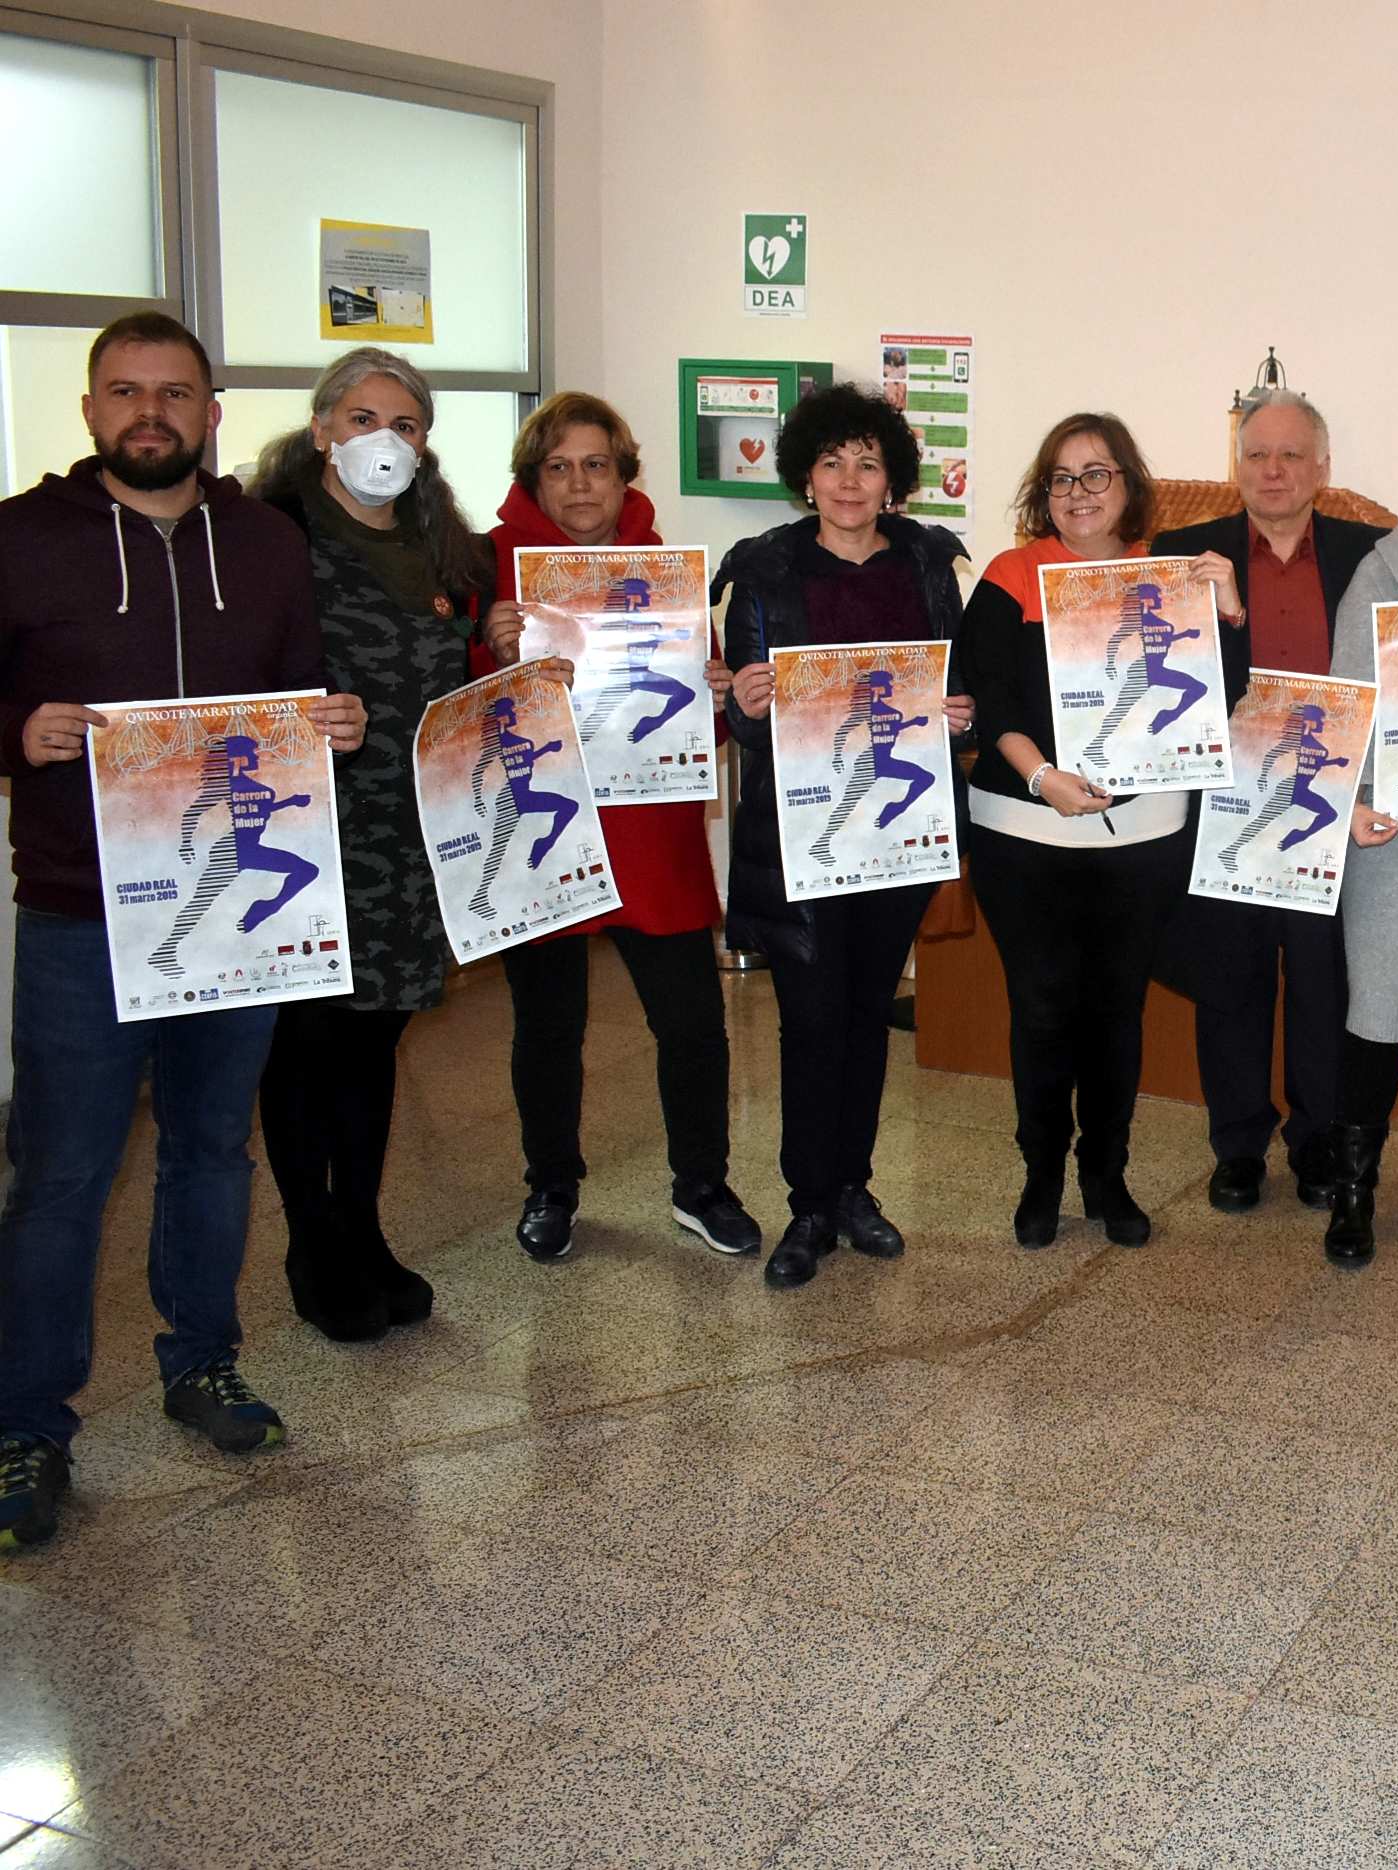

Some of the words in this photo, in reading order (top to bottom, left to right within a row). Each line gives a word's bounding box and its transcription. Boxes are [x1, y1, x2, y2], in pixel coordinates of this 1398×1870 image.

[752, 290, 795, 307] DEA
[379, 464, 391, 472] 3M
[125, 708, 186, 723] QVIXOTE
[189, 702, 257, 718] MARATÓN
[259, 700, 298, 713] ADAD
[232, 788, 271, 802] Carrera
[233, 803, 248, 814] de
[248, 802, 259, 813] la
[235, 816, 265, 828] Mujer
[115, 880, 152, 894] CIUDAD
[152, 877, 178, 890] REAL
[117, 894, 129, 905] 31
[129, 893, 156, 903] marzo
[156, 889, 178, 901] 2019
